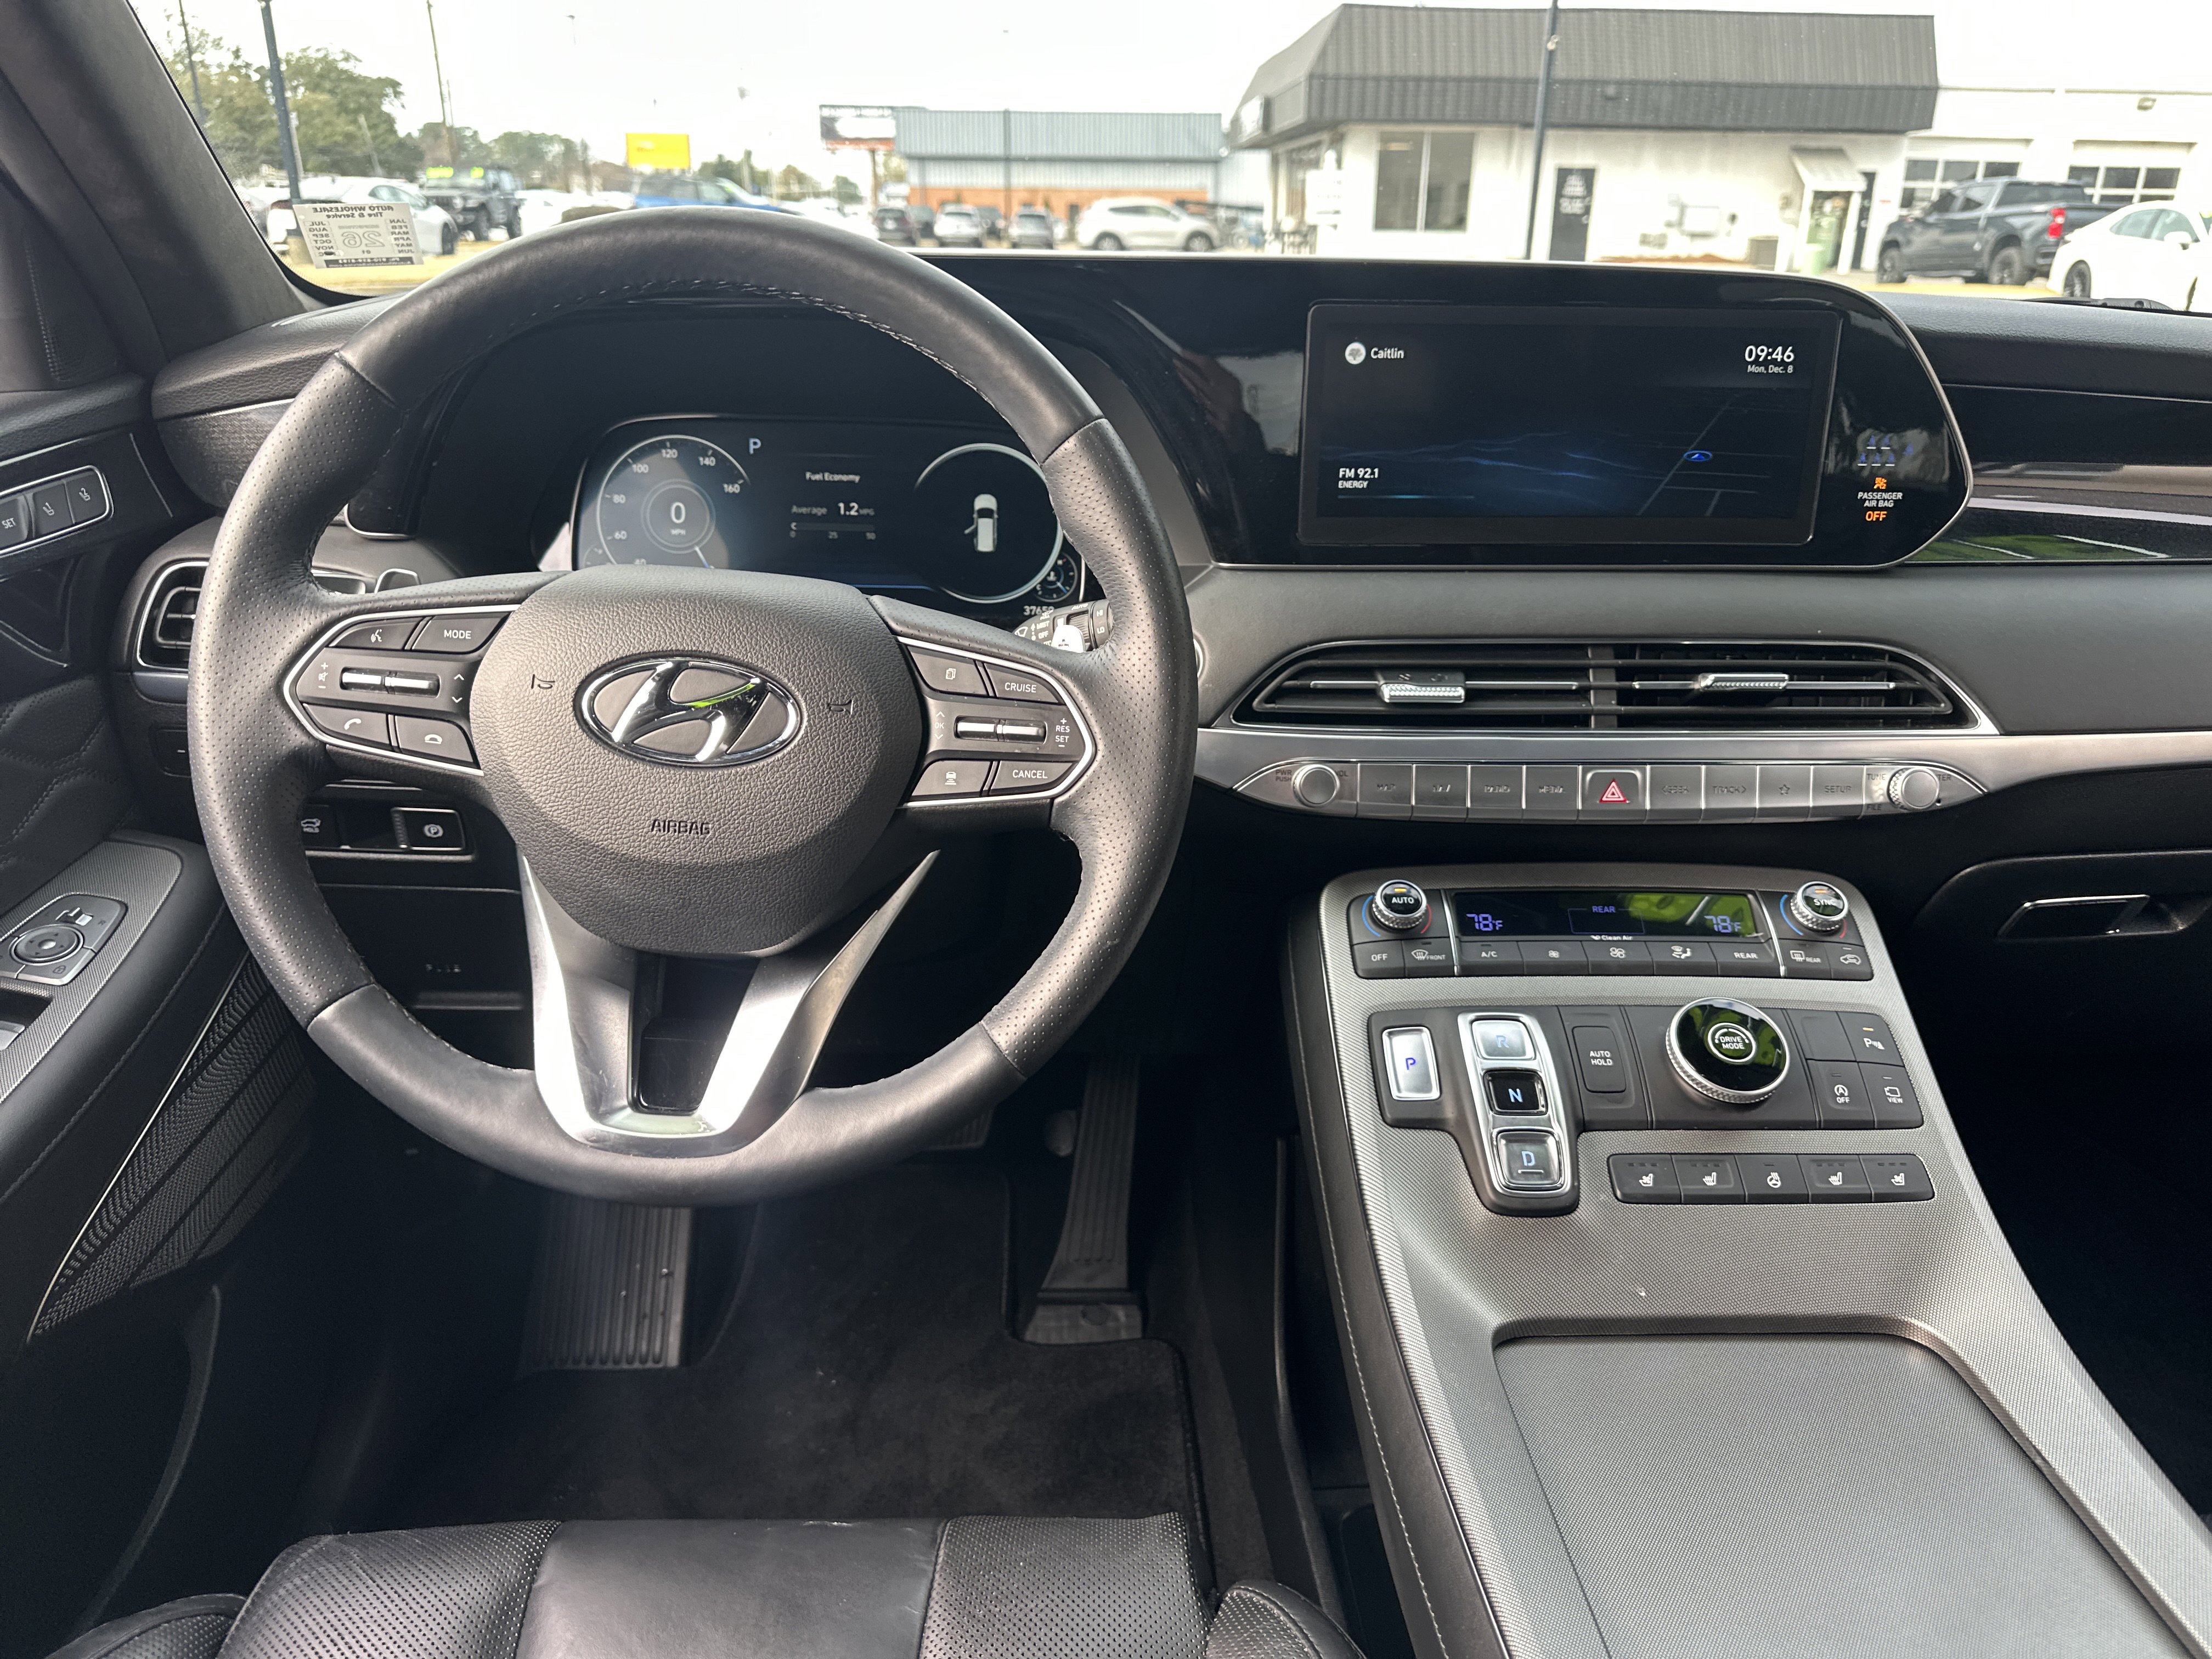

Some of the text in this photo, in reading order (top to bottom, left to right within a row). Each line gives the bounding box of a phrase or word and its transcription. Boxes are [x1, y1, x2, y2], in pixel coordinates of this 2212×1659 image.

[1370, 347, 1404, 359] Caitlin
[1745, 345, 1795, 362] 09:46
[1768, 365, 1785, 373] Dec.
[1787, 365, 1793, 373] 8
[749, 438, 761, 454] P
[661, 449, 678, 458] 120
[698, 456, 715, 466] 140
[632, 464, 648, 473] 100
[1339, 467, 1379, 478] FM 92.1
[805, 471, 860, 483] Fuel Economy
[723, 484, 740, 493] 160
[1338, 480, 1369, 488] ENERGY
[613, 494, 625, 503] 80
[1857, 492, 1903, 500] PASSENGER
[670, 502, 686, 523] 0
[791, 505, 827, 516] Average
[838, 502, 859, 516] 1.2
[1865, 511, 1887, 521] OFF
[2, 517, 16, 529] SET
[614, 531, 627, 539] 60
[444, 629, 471, 639] MODE
[1038, 631, 1048, 639] OFF
[1005, 682, 1037, 693] CRUISE
[934, 721, 944, 730] OK
[1056, 725, 1070, 733] RES
[1012, 770, 1048, 779] CANCEL
[651, 819, 711, 834] AIRBAG
[1496, 1035, 1509, 1048] R
[1406, 1058, 1416, 1070] P
[1508, 1088, 1523, 1103] N
[1522, 1151, 1536, 1166] D
